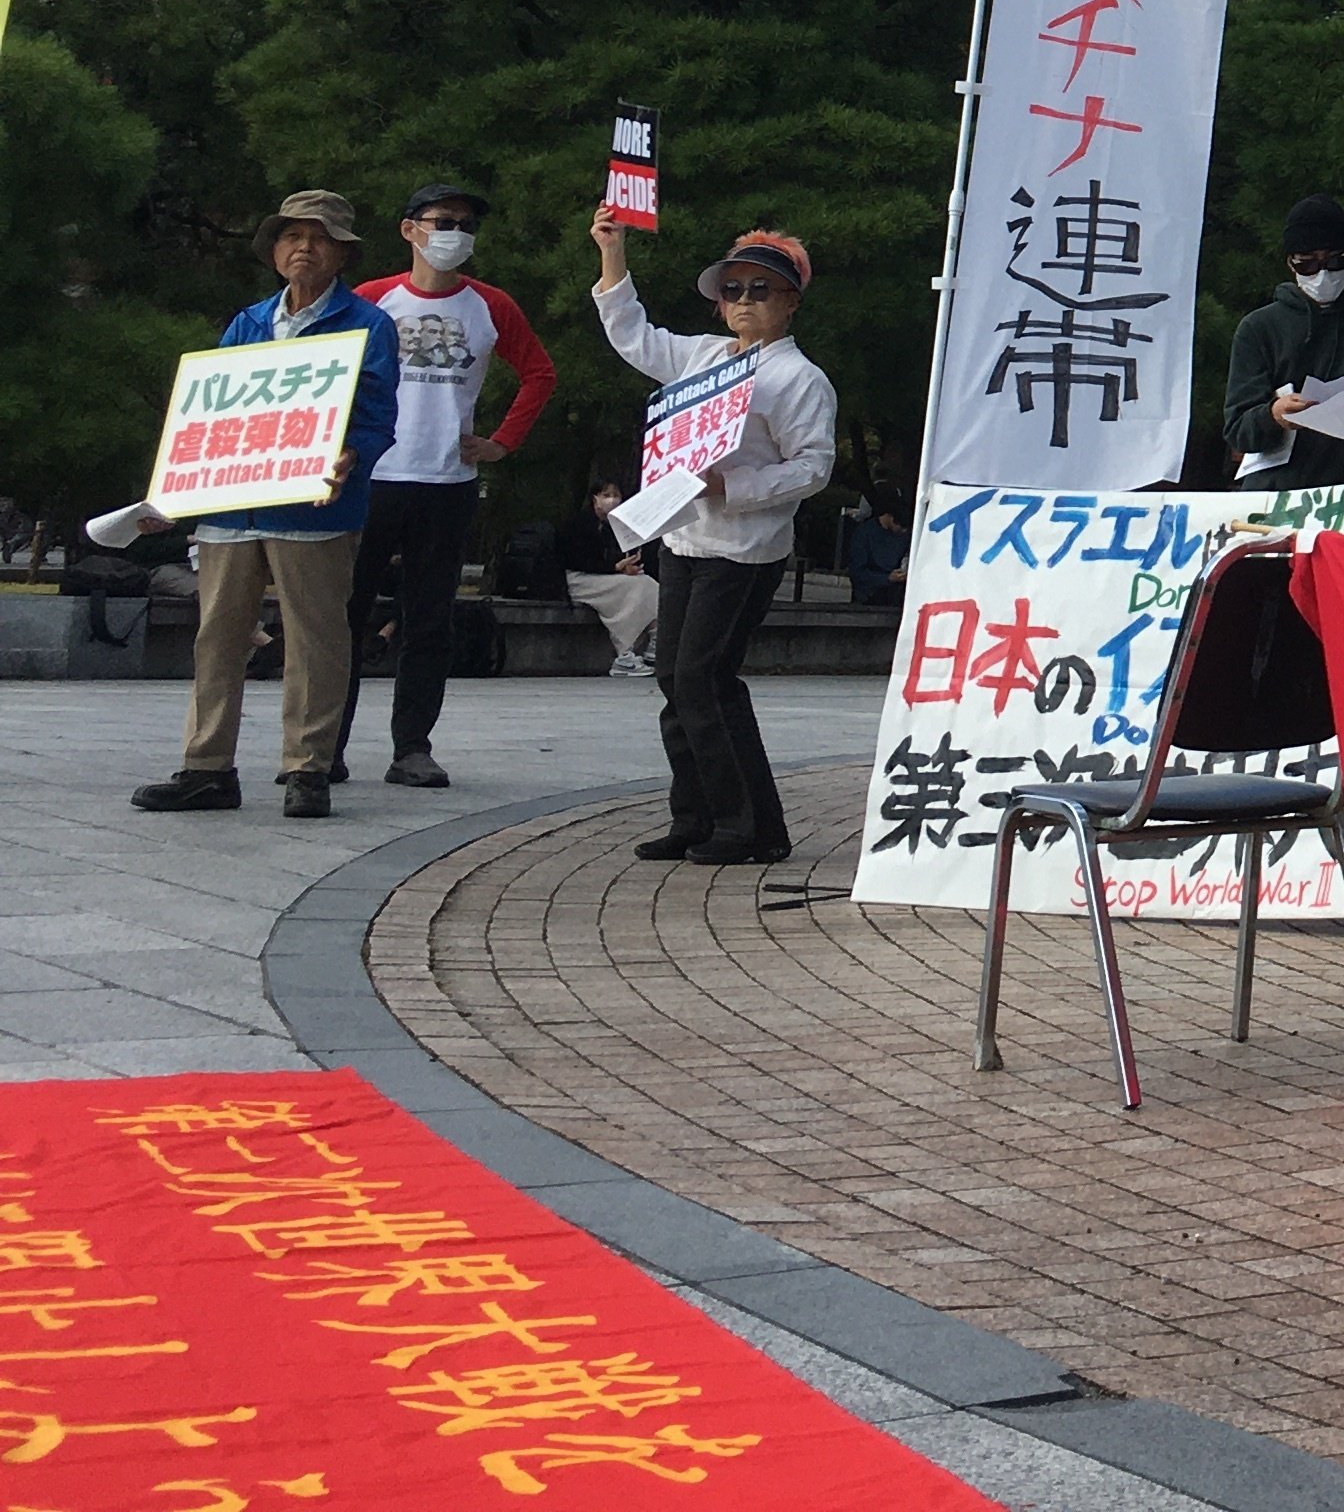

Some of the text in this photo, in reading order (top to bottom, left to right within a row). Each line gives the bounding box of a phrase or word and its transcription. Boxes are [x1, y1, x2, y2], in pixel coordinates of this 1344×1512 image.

[180, 359, 349, 415] パレスチナ
[647, 394, 674, 424] Don't
[675, 374, 716, 406] attack
[717, 361, 747, 385] GAZA
[642, 377, 754, 470] 大量殺戮
[161, 456, 326, 494] Don't attack gaza
[86, 1099, 762, 1496] 第三次世界大戦を
